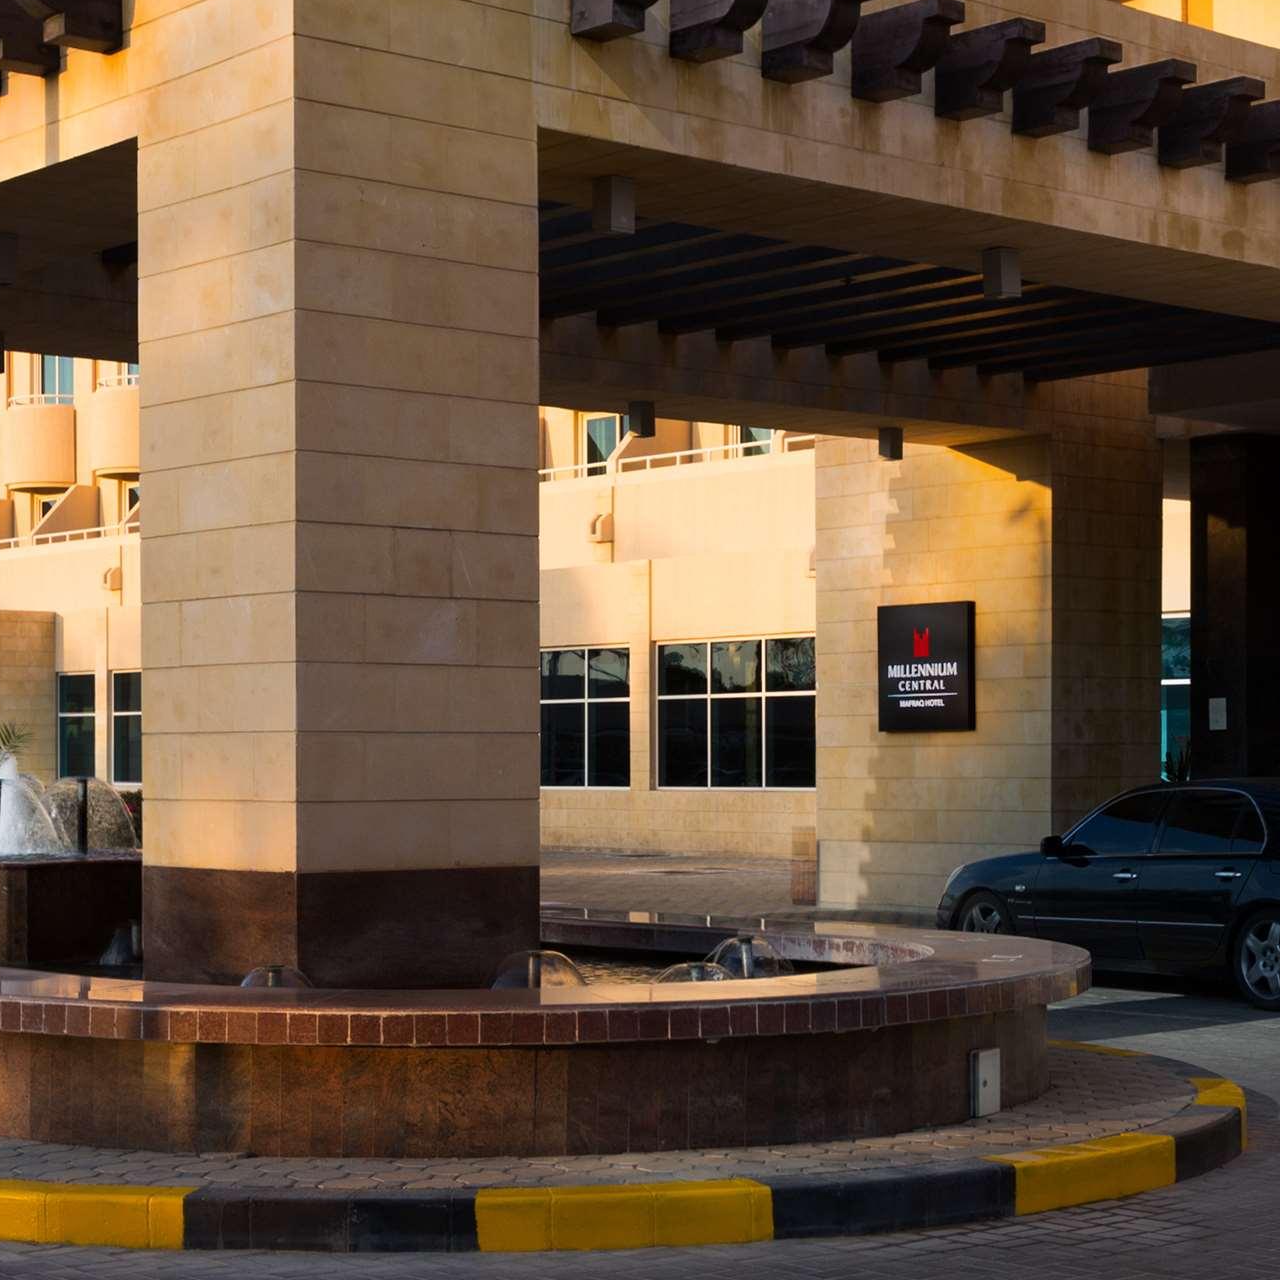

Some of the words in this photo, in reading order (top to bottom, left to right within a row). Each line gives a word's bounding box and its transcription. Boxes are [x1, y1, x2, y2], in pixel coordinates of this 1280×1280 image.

[887, 662, 958, 679] MILLENNIUM
[898, 679, 946, 692] CENTRAL
[925, 698, 945, 707] HOTEL
